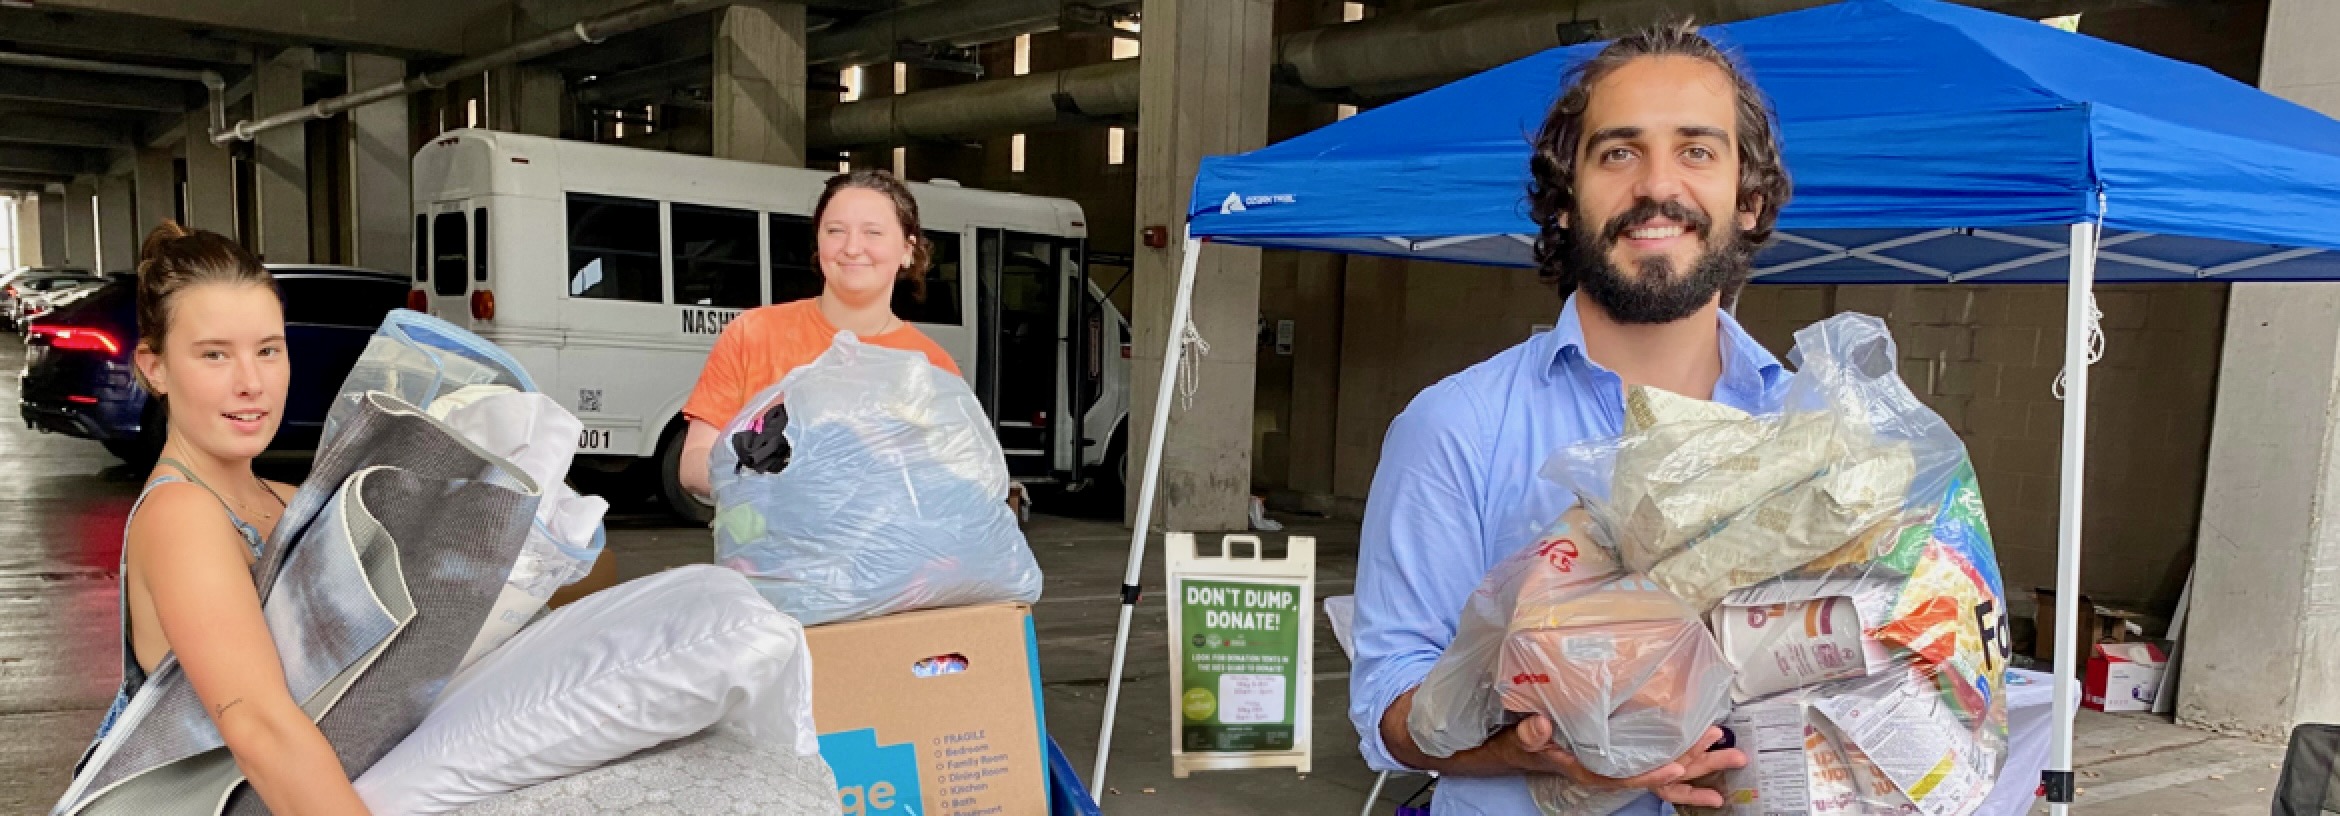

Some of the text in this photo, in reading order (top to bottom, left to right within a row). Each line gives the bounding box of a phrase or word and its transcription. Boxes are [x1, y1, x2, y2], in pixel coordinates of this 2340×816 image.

[1187, 586, 1297, 612] DON'T DUMP,
[1206, 609, 1280, 631] DONATE!
[944, 730, 985, 744] FRAGILE
[946, 744, 989, 757] Bedroom
[947, 754, 1009, 770] Family Room
[949, 767, 1009, 783] Dining Room
